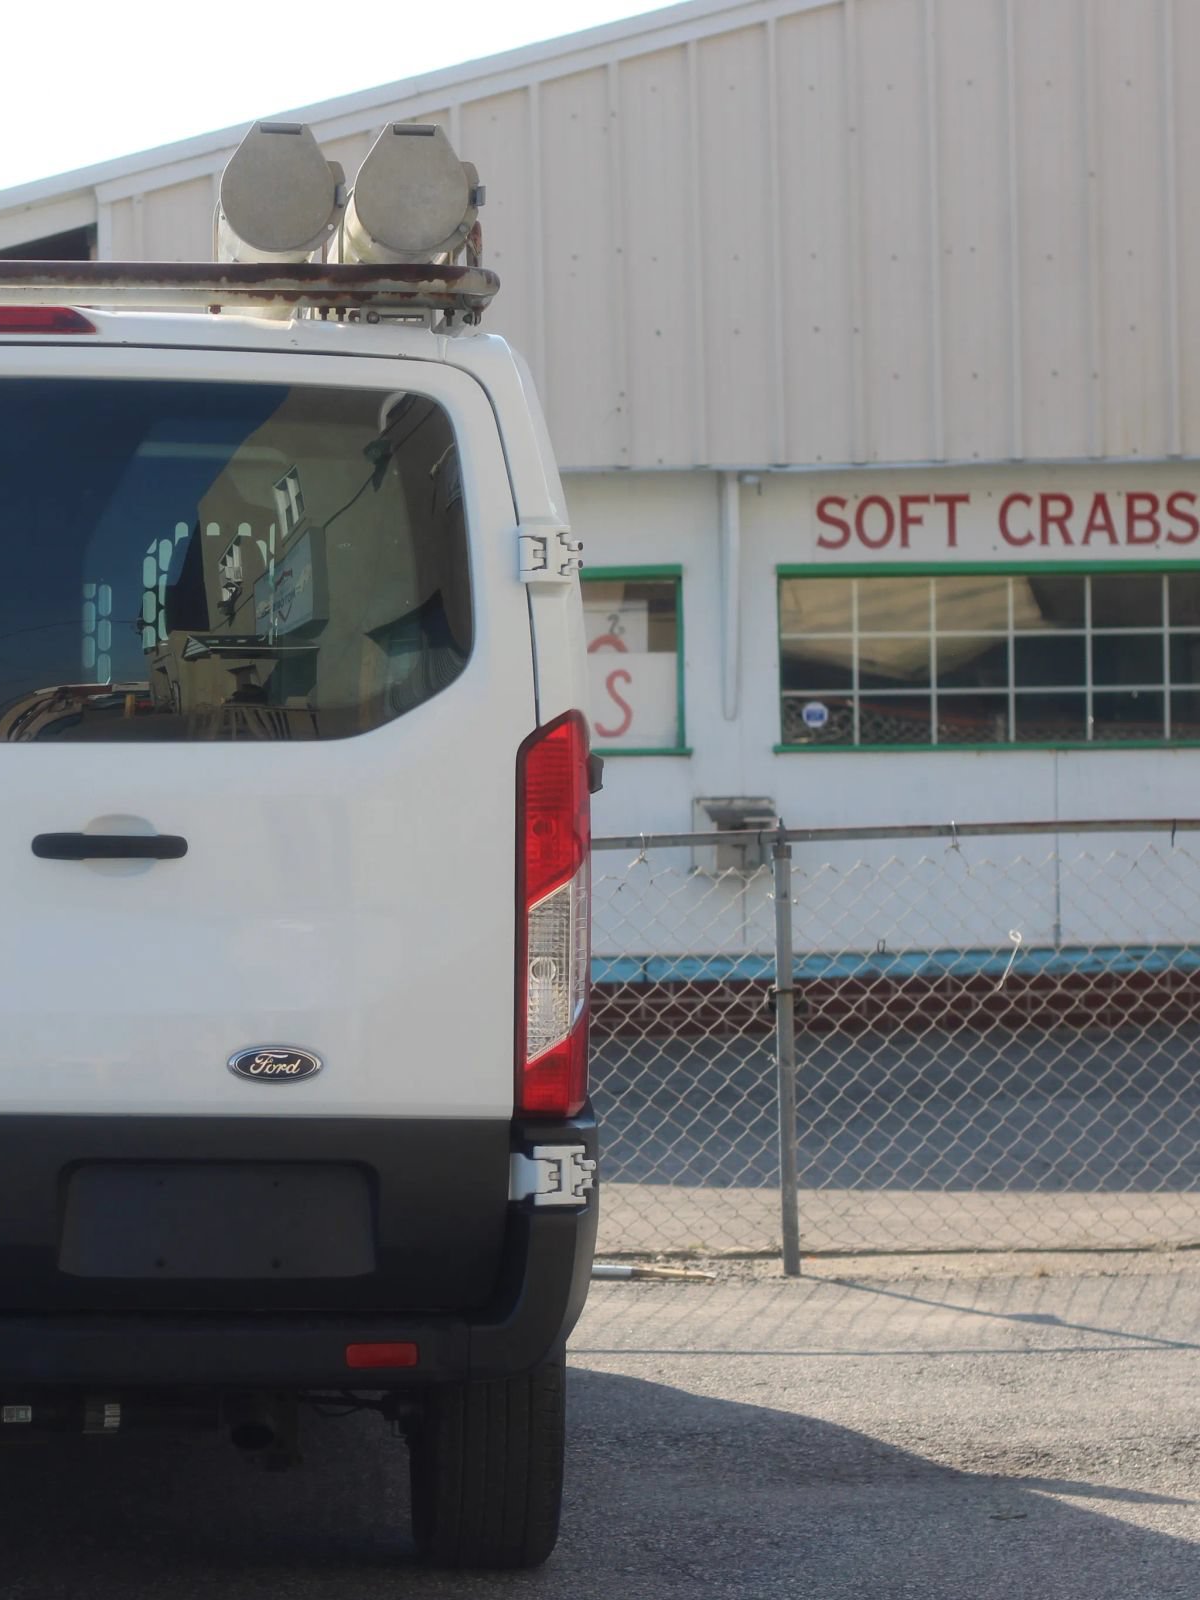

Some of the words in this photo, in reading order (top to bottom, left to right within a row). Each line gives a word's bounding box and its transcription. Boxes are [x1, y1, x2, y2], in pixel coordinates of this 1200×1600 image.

[816, 493, 970, 549] SOFT
[998, 491, 1200, 546] CRABS
[249, 1053, 302, 1074] Ford
